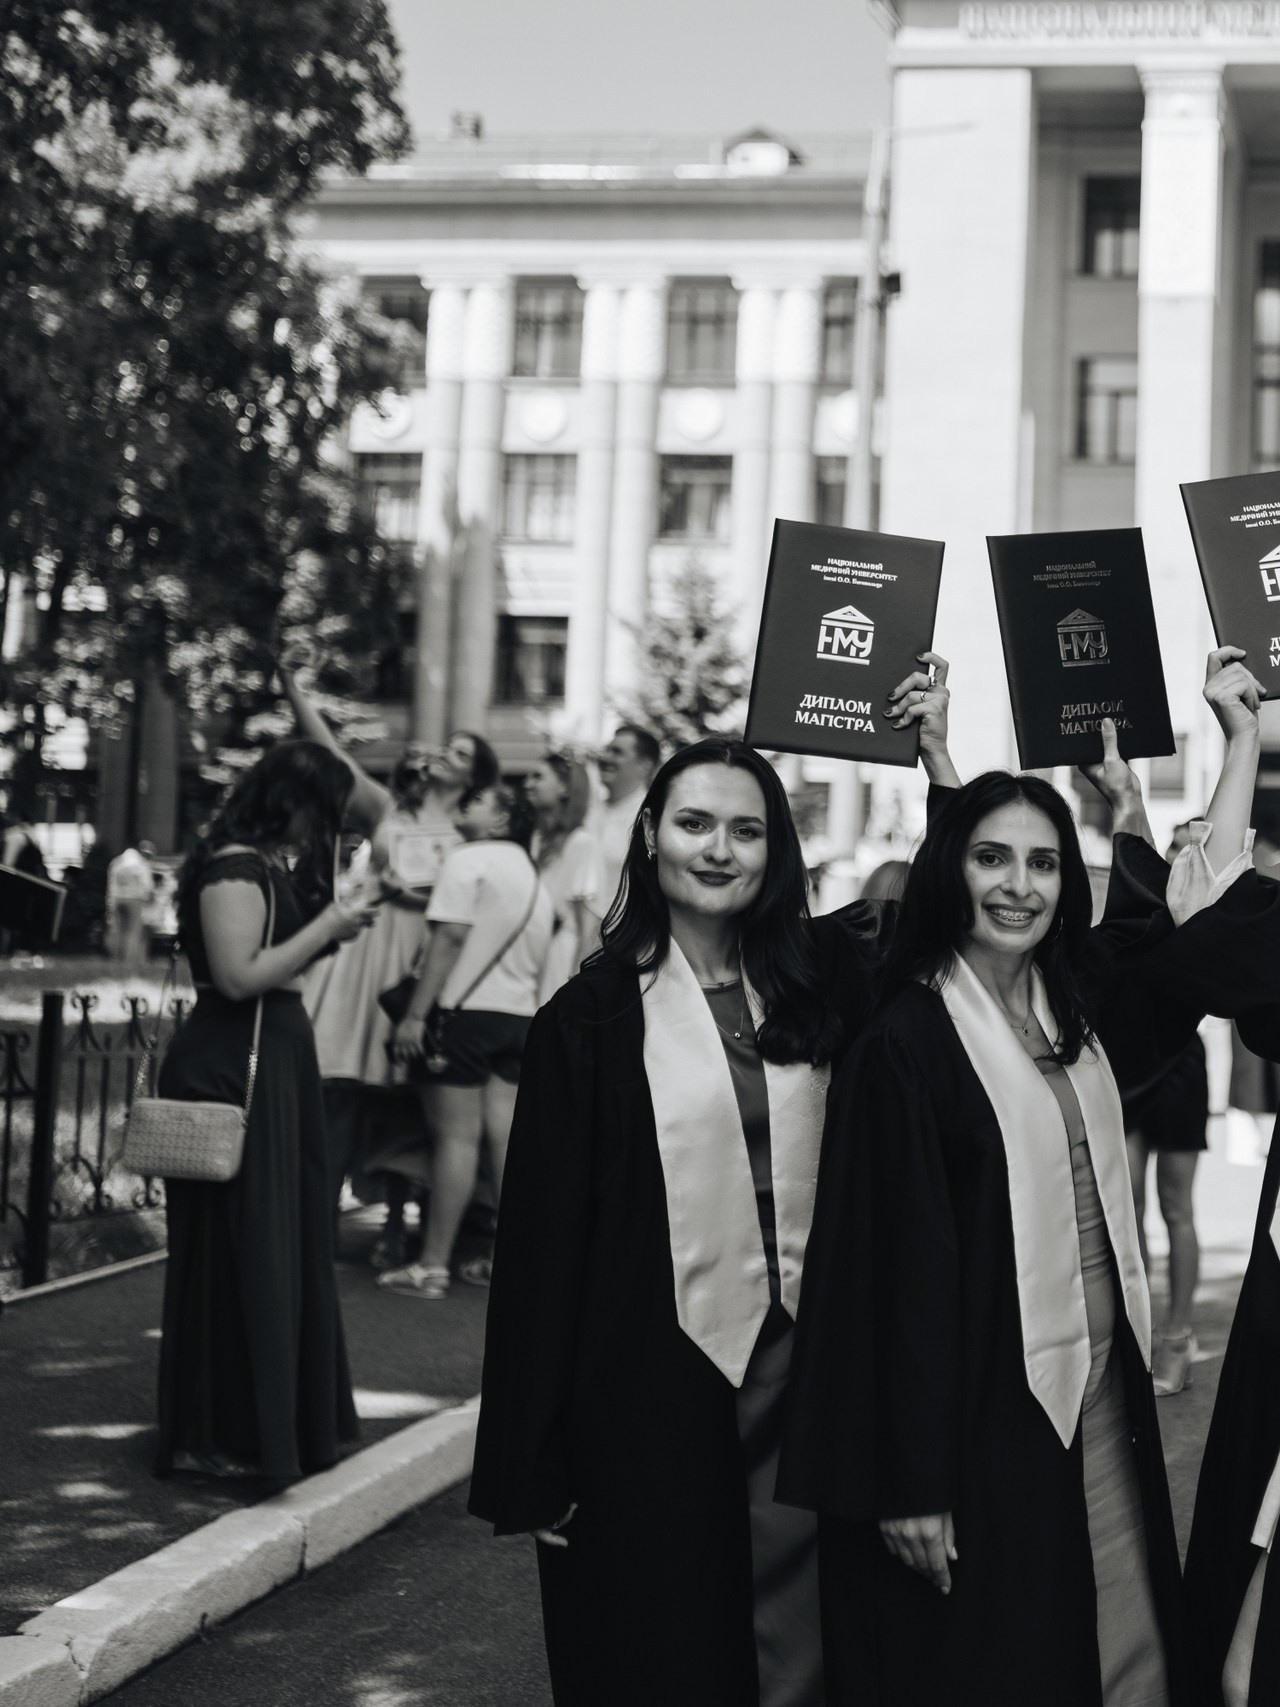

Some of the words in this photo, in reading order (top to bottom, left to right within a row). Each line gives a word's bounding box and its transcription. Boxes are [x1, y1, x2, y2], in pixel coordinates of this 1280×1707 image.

[1230, 511, 1268, 522] МЕДИЧНИЙ
[811, 564, 850, 575] МЕДИЧНИЙ
[851, 569, 898, 581] УНІВЕРСИТЕТ
[827, 558, 883, 571] НАЦІОНАЛЬНИЙ
[799, 693, 872, 715] ДИПЛОМ
[1060, 699, 1124, 719] ДИПЛОМ
[794, 709, 876, 734] МАГІСТРА
[1060, 716, 1133, 735] МАГІСРА
